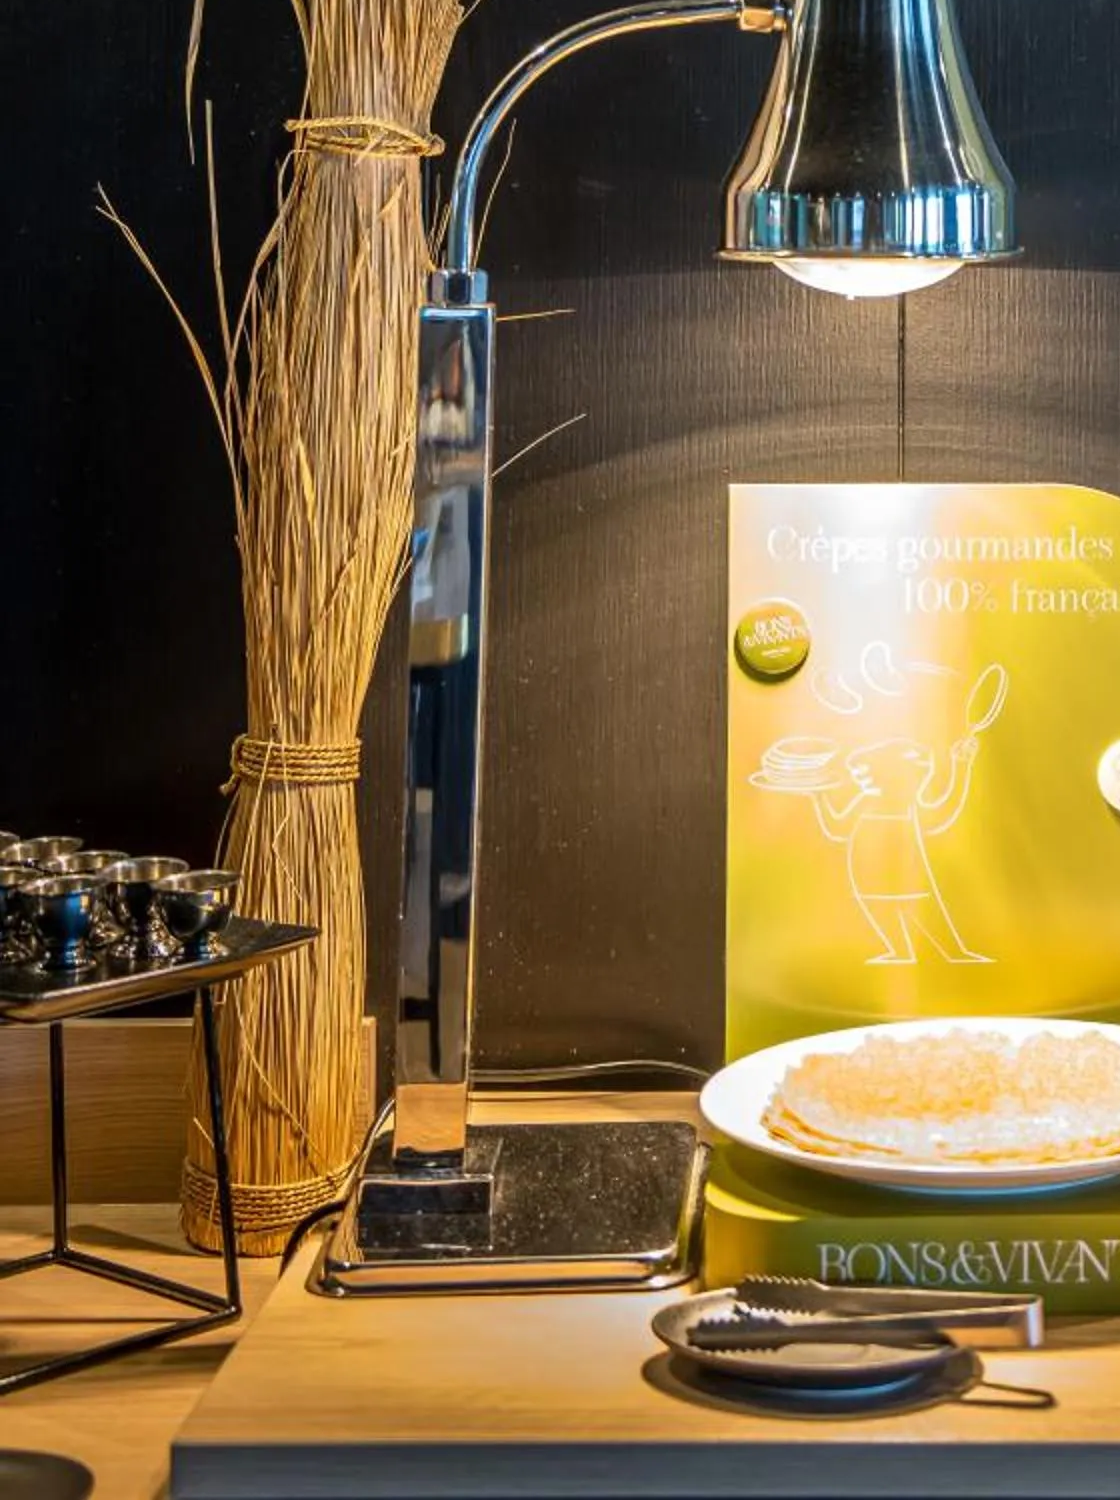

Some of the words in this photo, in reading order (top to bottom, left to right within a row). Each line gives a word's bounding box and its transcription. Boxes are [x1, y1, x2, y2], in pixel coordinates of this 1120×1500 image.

[766, 524, 888, 573] Crêpes
[896, 526, 1113, 574] gourmandes
[904, 580, 997, 614] 100%
